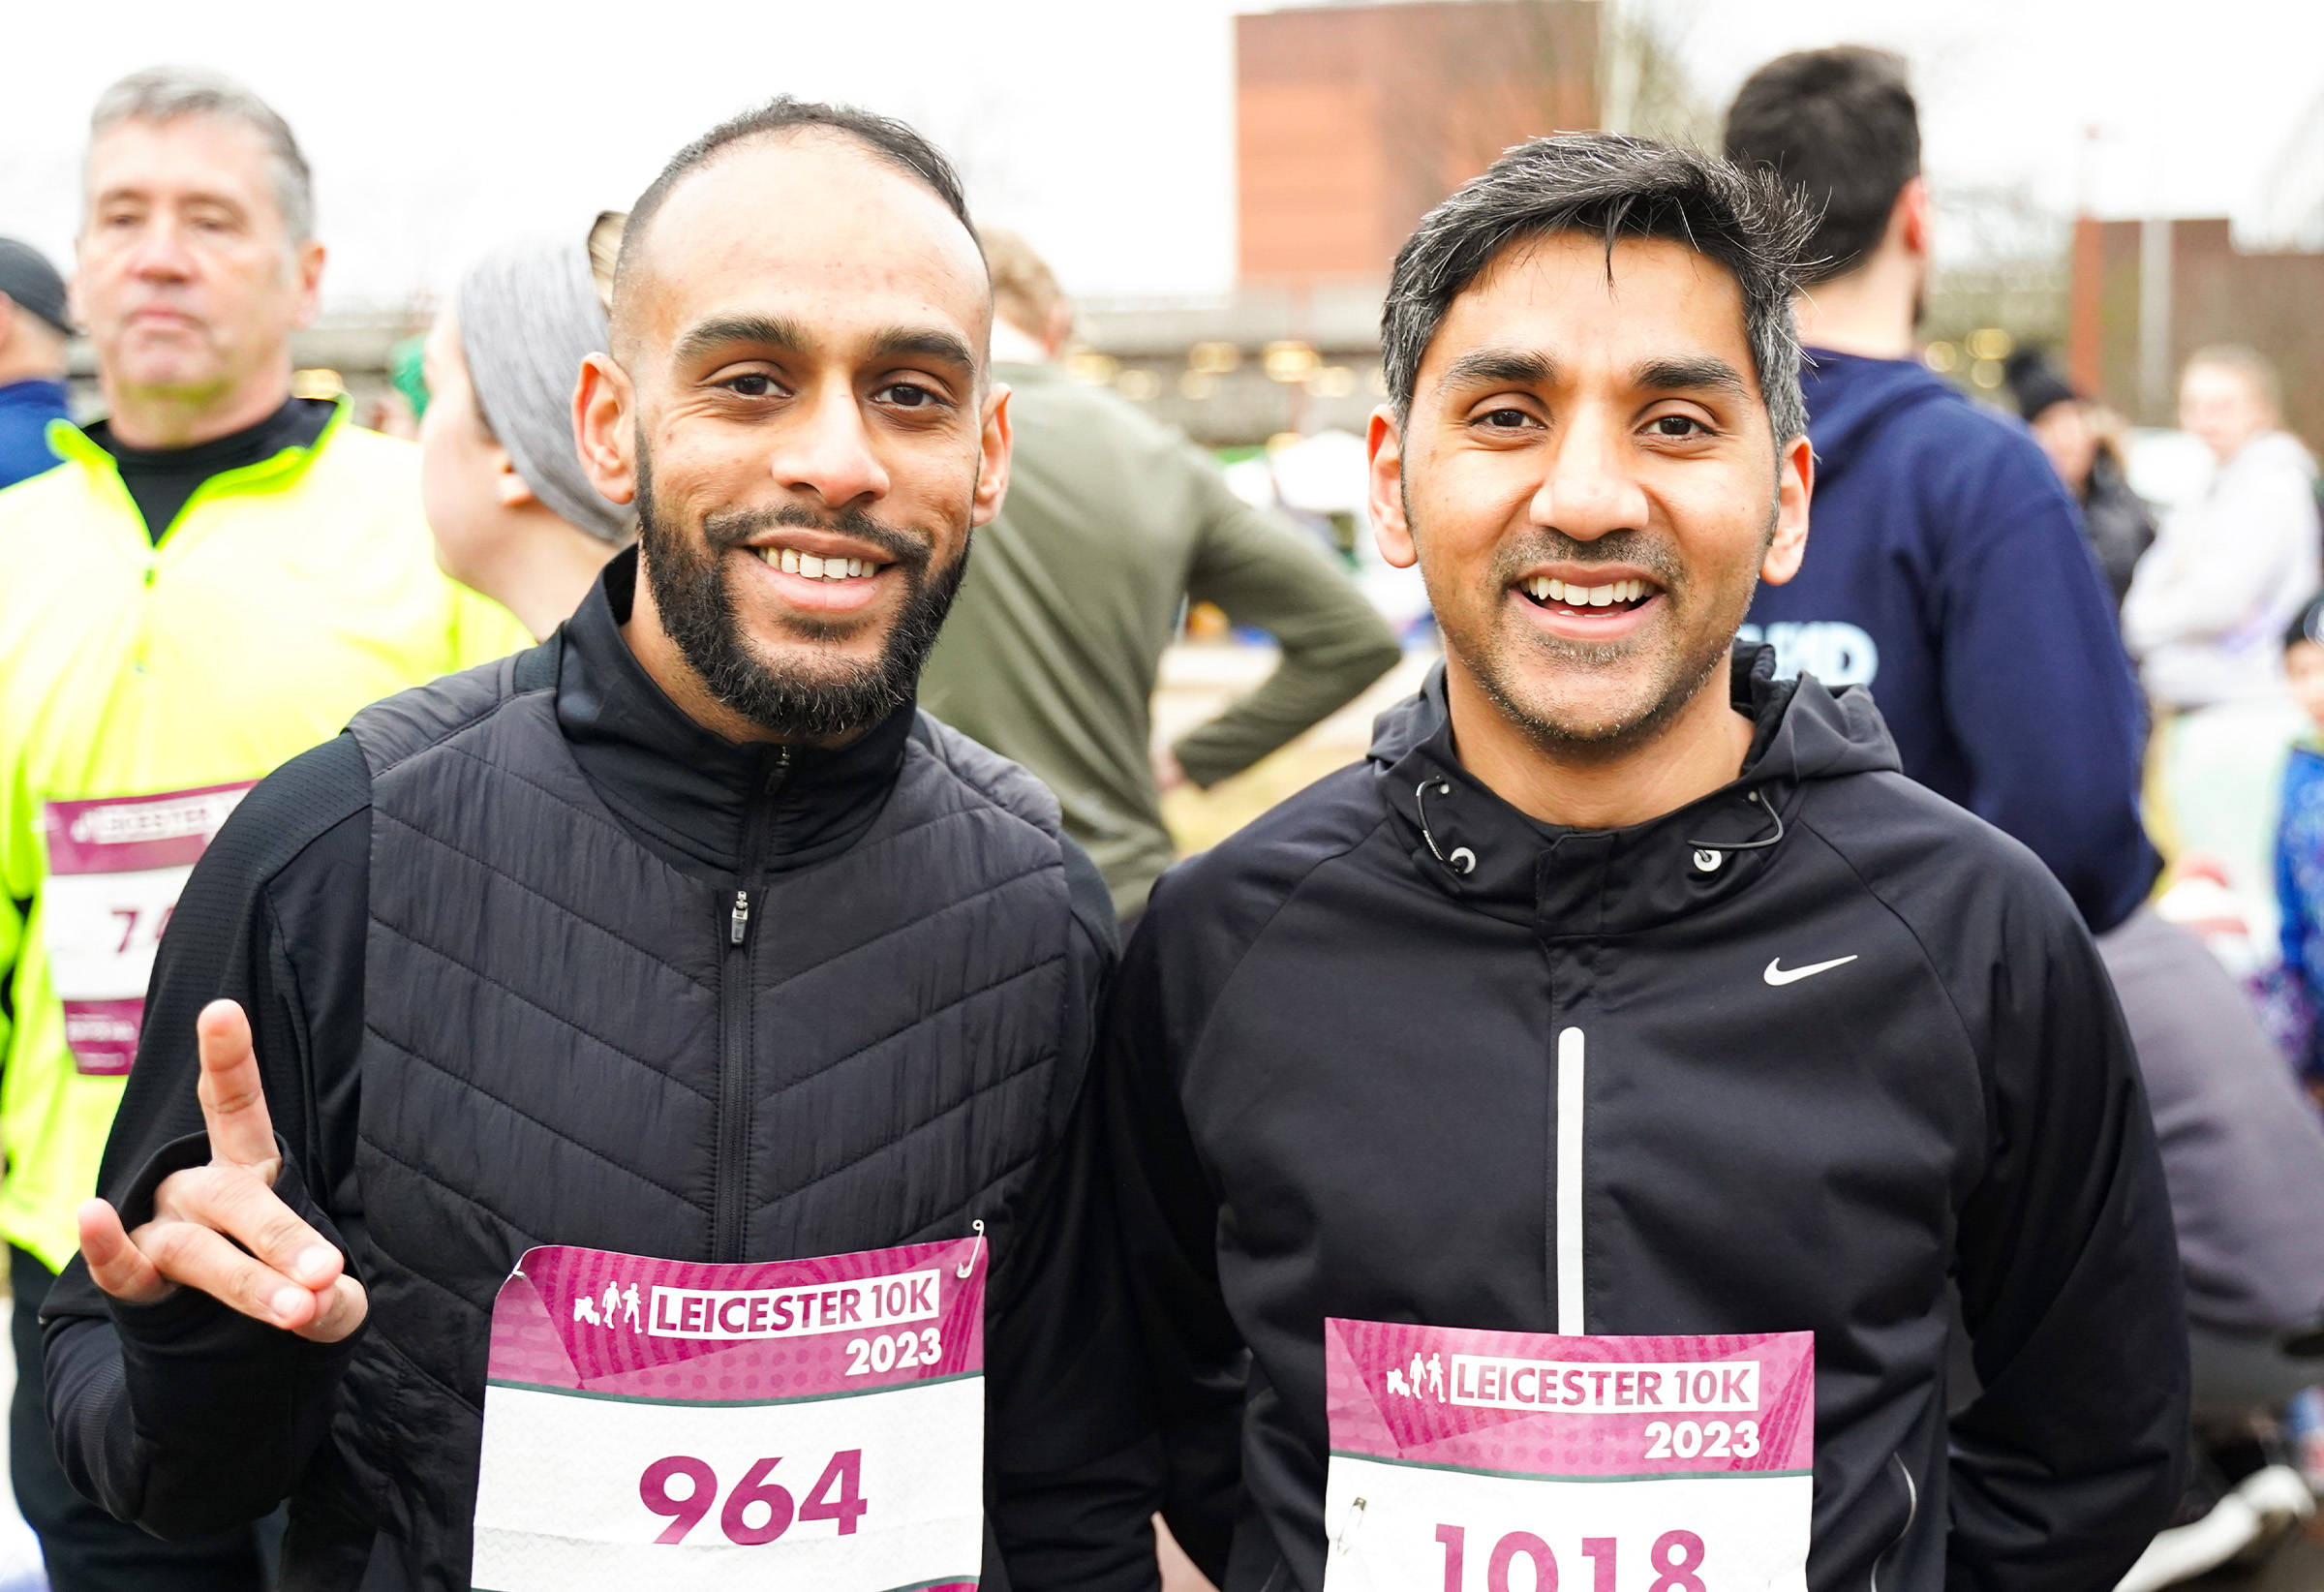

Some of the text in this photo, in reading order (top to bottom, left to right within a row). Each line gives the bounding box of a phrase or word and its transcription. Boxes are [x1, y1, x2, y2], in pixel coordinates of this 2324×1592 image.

[656, 1276, 934, 1333] LEICESTER 10K
[844, 1327, 942, 1376] 2023
[1456, 1363, 1753, 1406] LEICESTER 10K
[1644, 1420, 1760, 1459] 2023
[639, 1448, 868, 1546] 964
[1435, 1523, 1708, 1592] 1018
